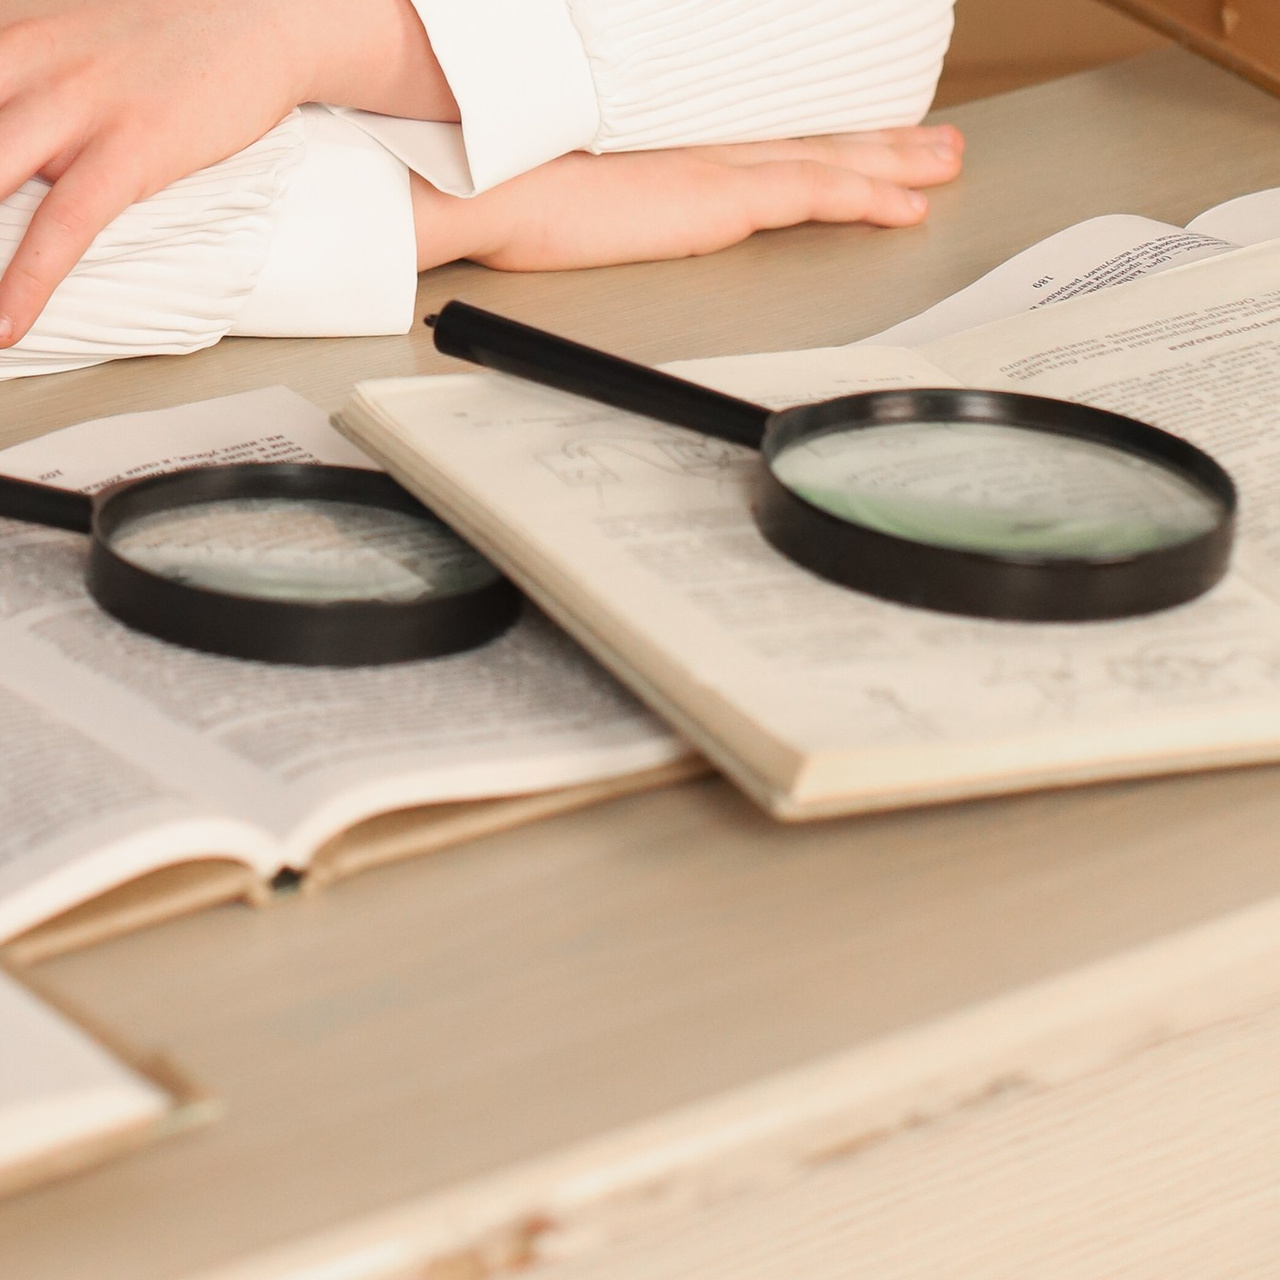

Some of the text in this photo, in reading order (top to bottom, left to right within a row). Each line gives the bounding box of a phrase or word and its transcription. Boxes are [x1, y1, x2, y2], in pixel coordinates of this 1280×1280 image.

[1030, 275, 1054, 289] 189
[1082, 261, 1143, 295] производим
[1108, 269, 1146, 286] katha
